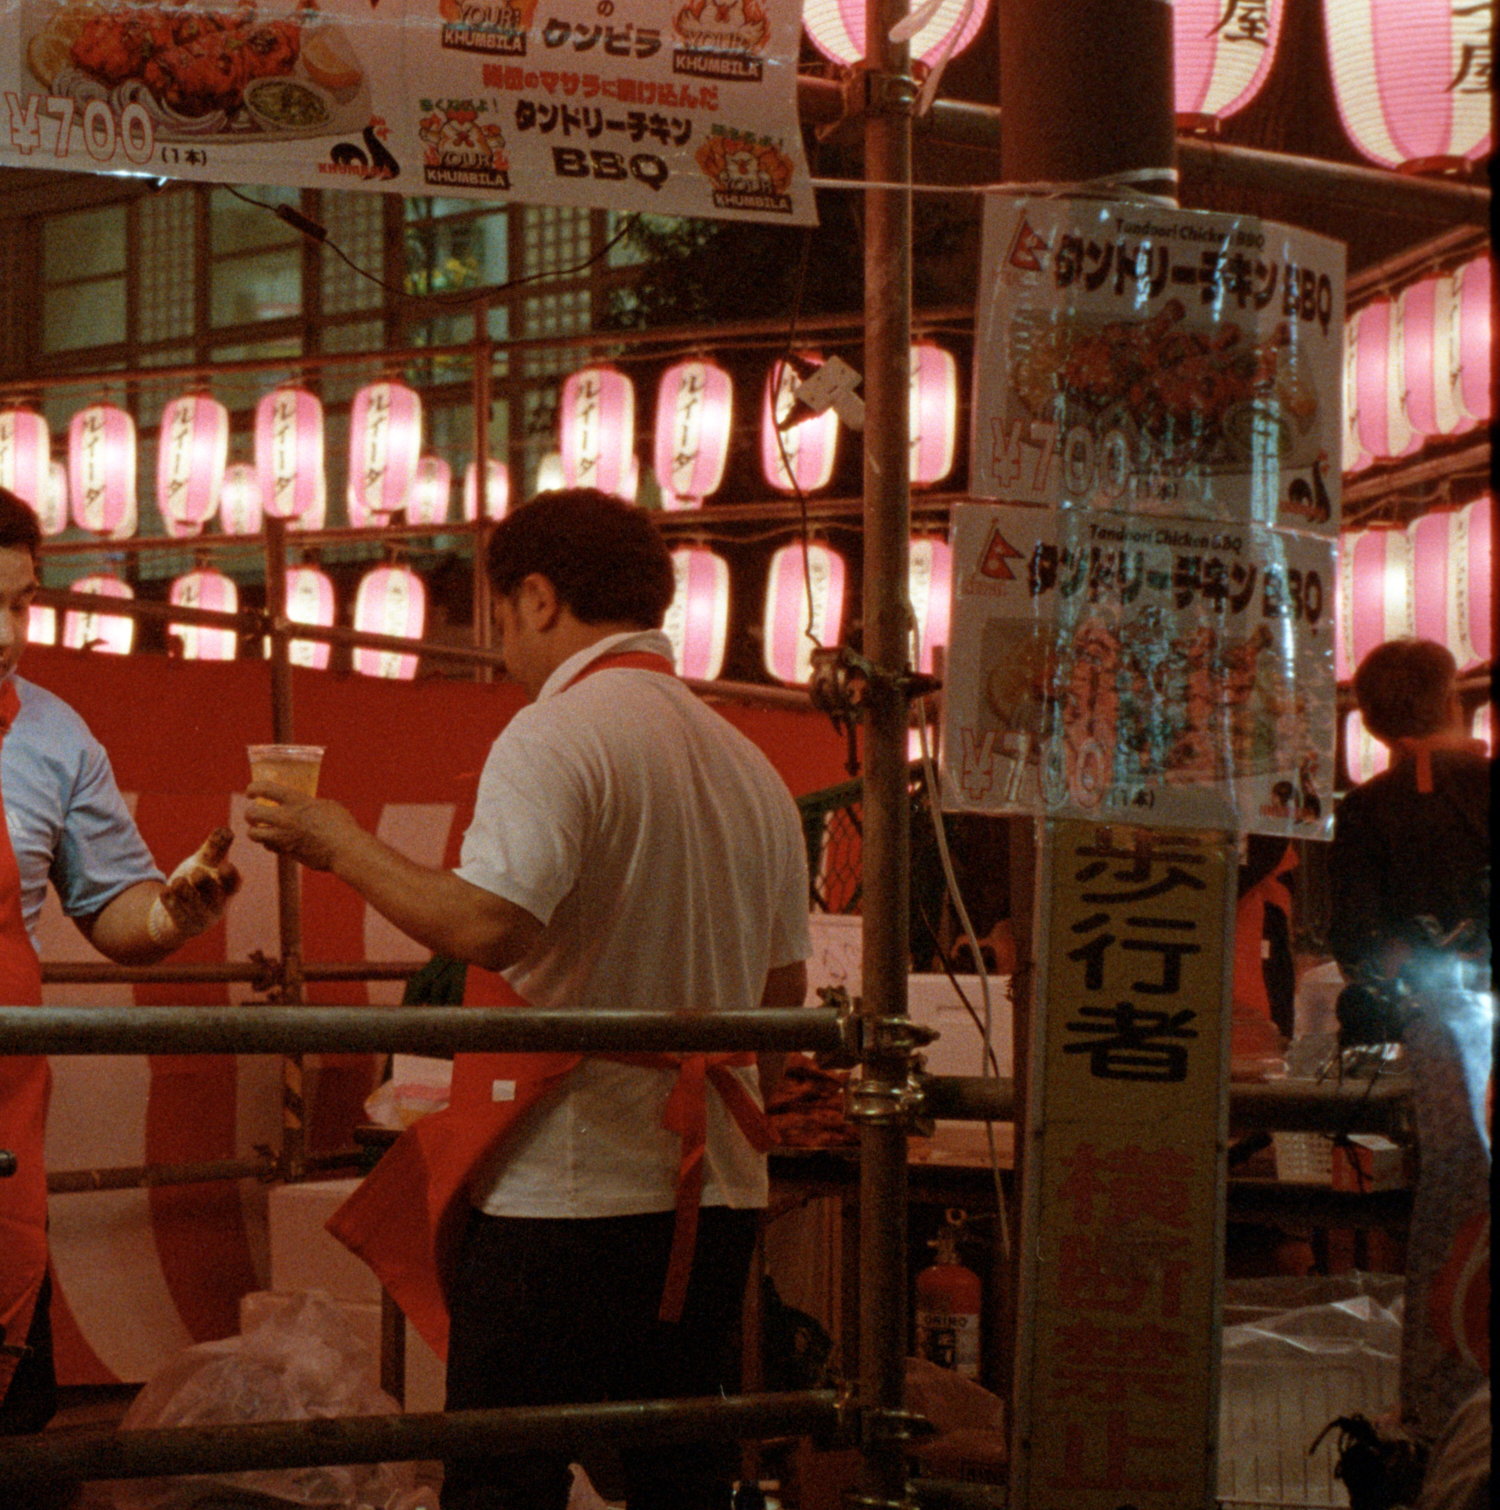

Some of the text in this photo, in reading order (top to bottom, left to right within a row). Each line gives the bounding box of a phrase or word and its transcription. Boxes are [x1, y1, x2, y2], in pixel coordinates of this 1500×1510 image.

[597, 0, 615, 17] の
[444, 29, 524, 52] KHUMBILA
[675, 54, 759, 77] KHUMBILA
[3, 91, 155, 165] ¥700
[514, 99, 693, 147] タンドリーチキン
[160, 146, 208, 167] (1本)
[426, 168, 506, 187] KHUMBILA
[551, 146, 670, 191] BBQ
[1115, 217, 1179, 240] Tandoori
[1054, 233, 1333, 338] タンドリーチキン BBQ
[1062, 827, 1207, 1083] 歩行者
